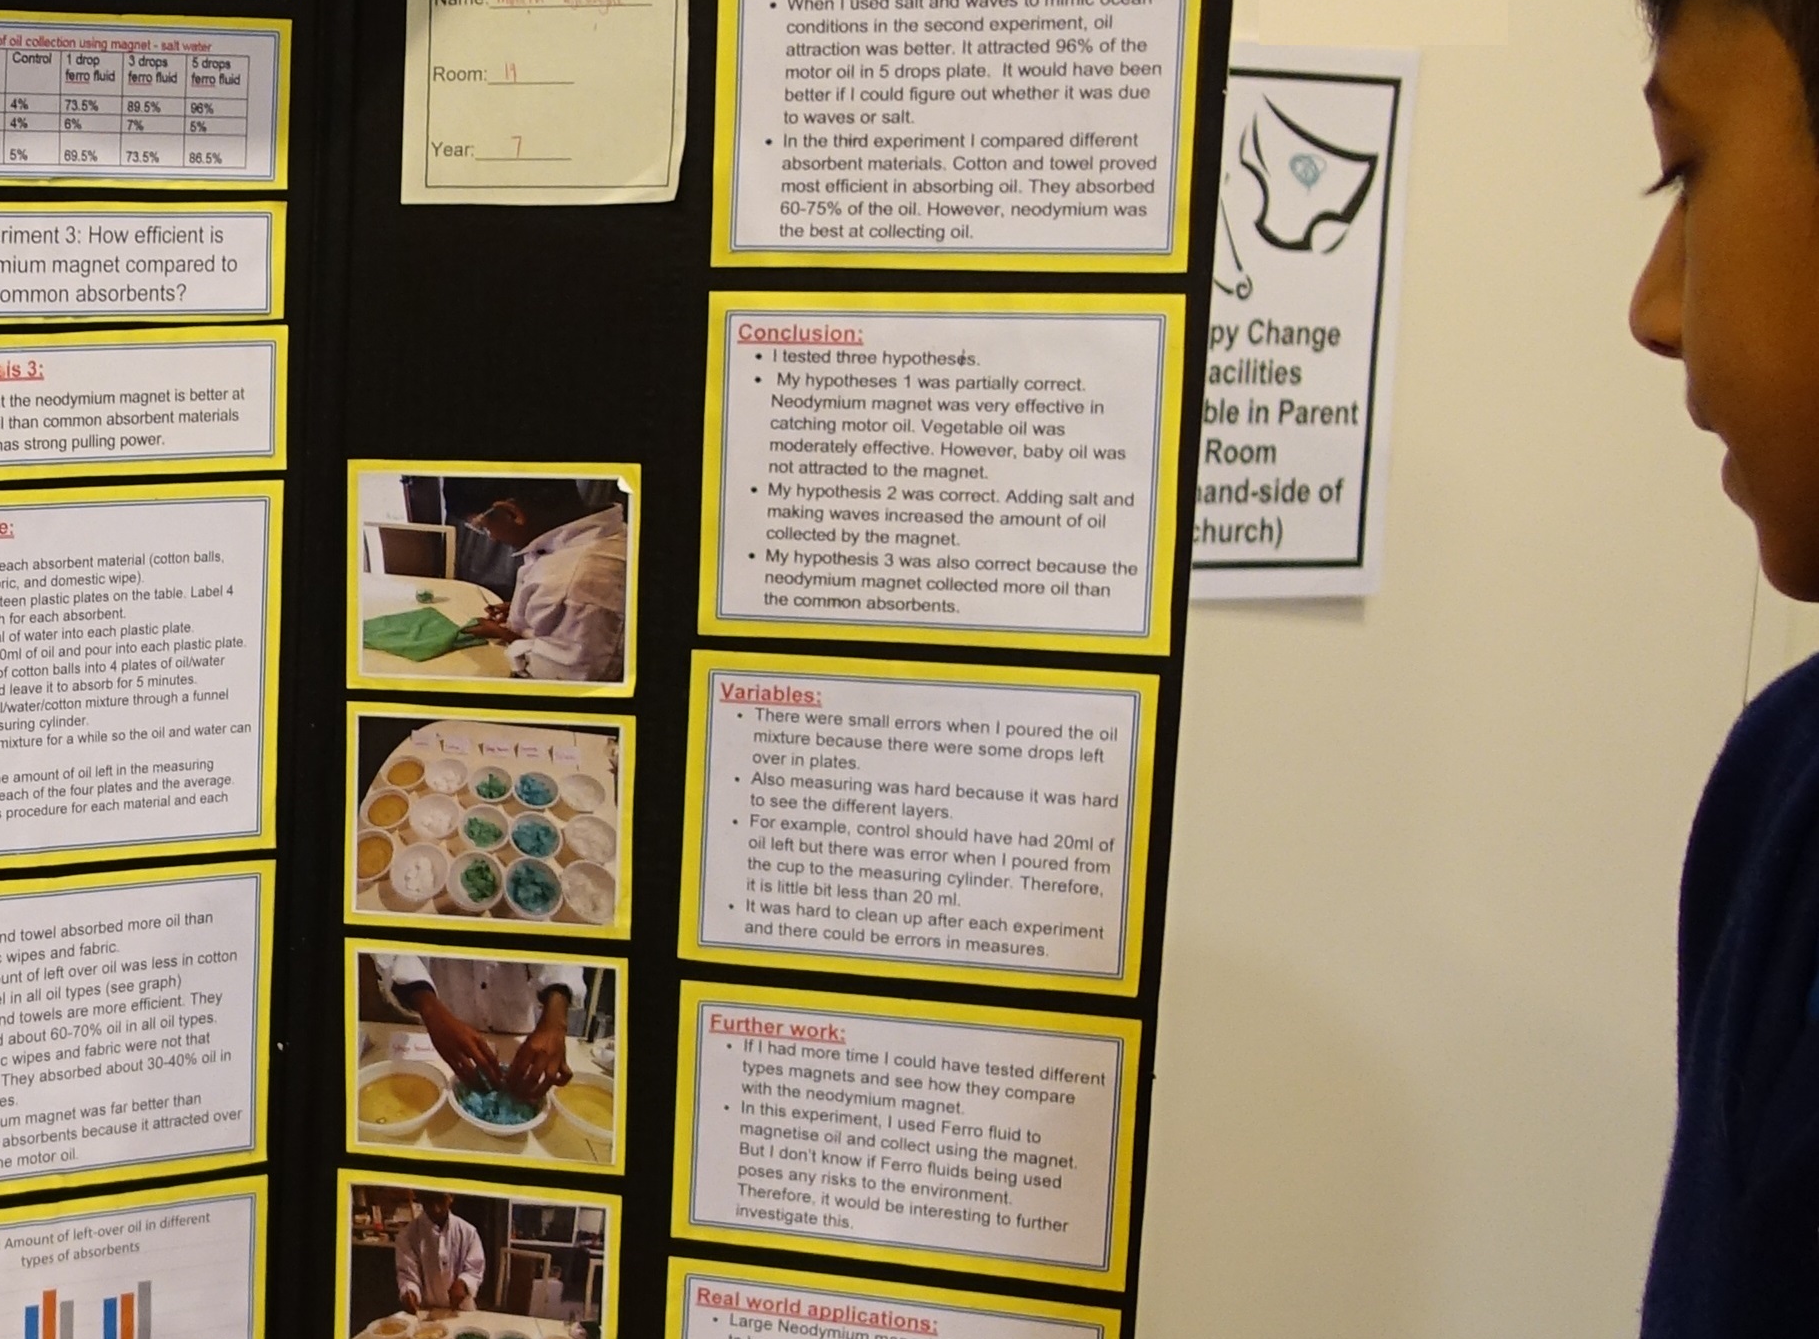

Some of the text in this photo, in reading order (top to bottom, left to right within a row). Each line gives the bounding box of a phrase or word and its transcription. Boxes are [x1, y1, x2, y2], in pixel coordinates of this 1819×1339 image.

[433, 66, 487, 82] Room:
[431, 141, 475, 158] Year:
[65, 225, 81, 244] 3:
[89, 225, 129, 244] How
[134, 225, 204, 244] efficient
[210, 225, 223, 243] is
[52, 255, 120, 278] magnet
[125, 254, 215, 277] compared
[221, 255, 237, 272] to
[75, 283, 186, 302] absorbents?
[737, 323, 864, 346] Conclusion:
[1247, 319, 1341, 351] Change
[27, 361, 44, 380] 3:
[1208, 359, 1302, 386] acilities
[1248, 398, 1269, 424] in
[1278, 398, 1359, 425] Parent
[1205, 439, 1276, 465] Room
[1318, 477, 1345, 504] of
[8, 629, 21, 642] of
[23, 629, 58, 641] water
[61, 627, 83, 639] into
[87, 624, 116, 638] each
[120, 622, 158, 639] plastic
[162, 621, 193, 640] plate.
[719, 682, 822, 707] Variables:
[710, 1014, 845, 1042] Further work:
[4, 1233, 54, 1250] Amount
[57, 1229, 71, 1243] of
[73, 1225, 124, 1241] left-over
[127, 1220, 141, 1233] oil
[145, 1219, 156, 1231] in
[159, 1212, 210, 1229] different
[696, 1288, 938, 1335] Real world applications:
